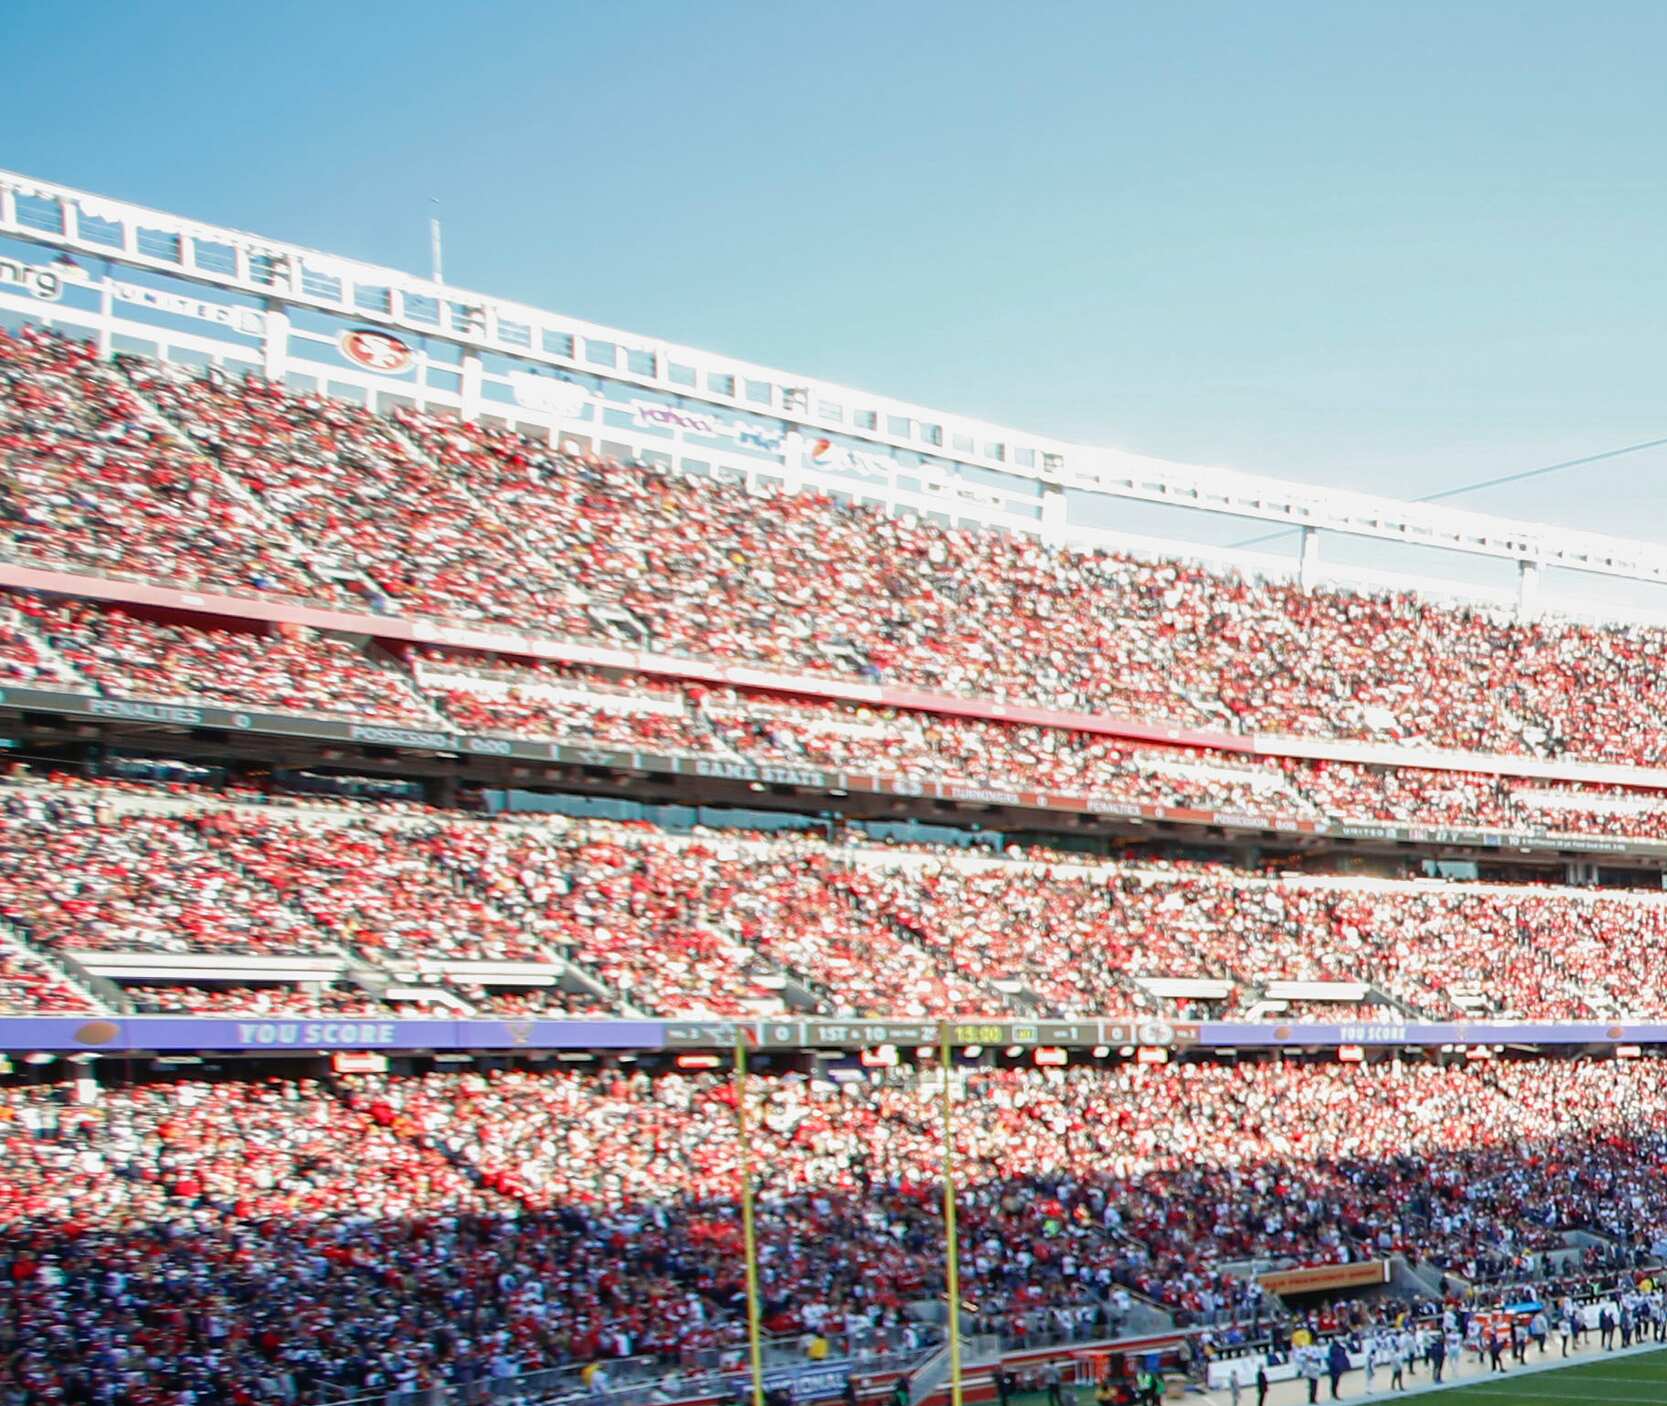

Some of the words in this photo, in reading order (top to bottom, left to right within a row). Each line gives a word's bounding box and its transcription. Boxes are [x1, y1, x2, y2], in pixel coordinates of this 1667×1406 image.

[89, 700, 202, 727] PENALTIES
[238, 1022, 298, 1045] YOU
[305, 1022, 394, 1045] SCORE
